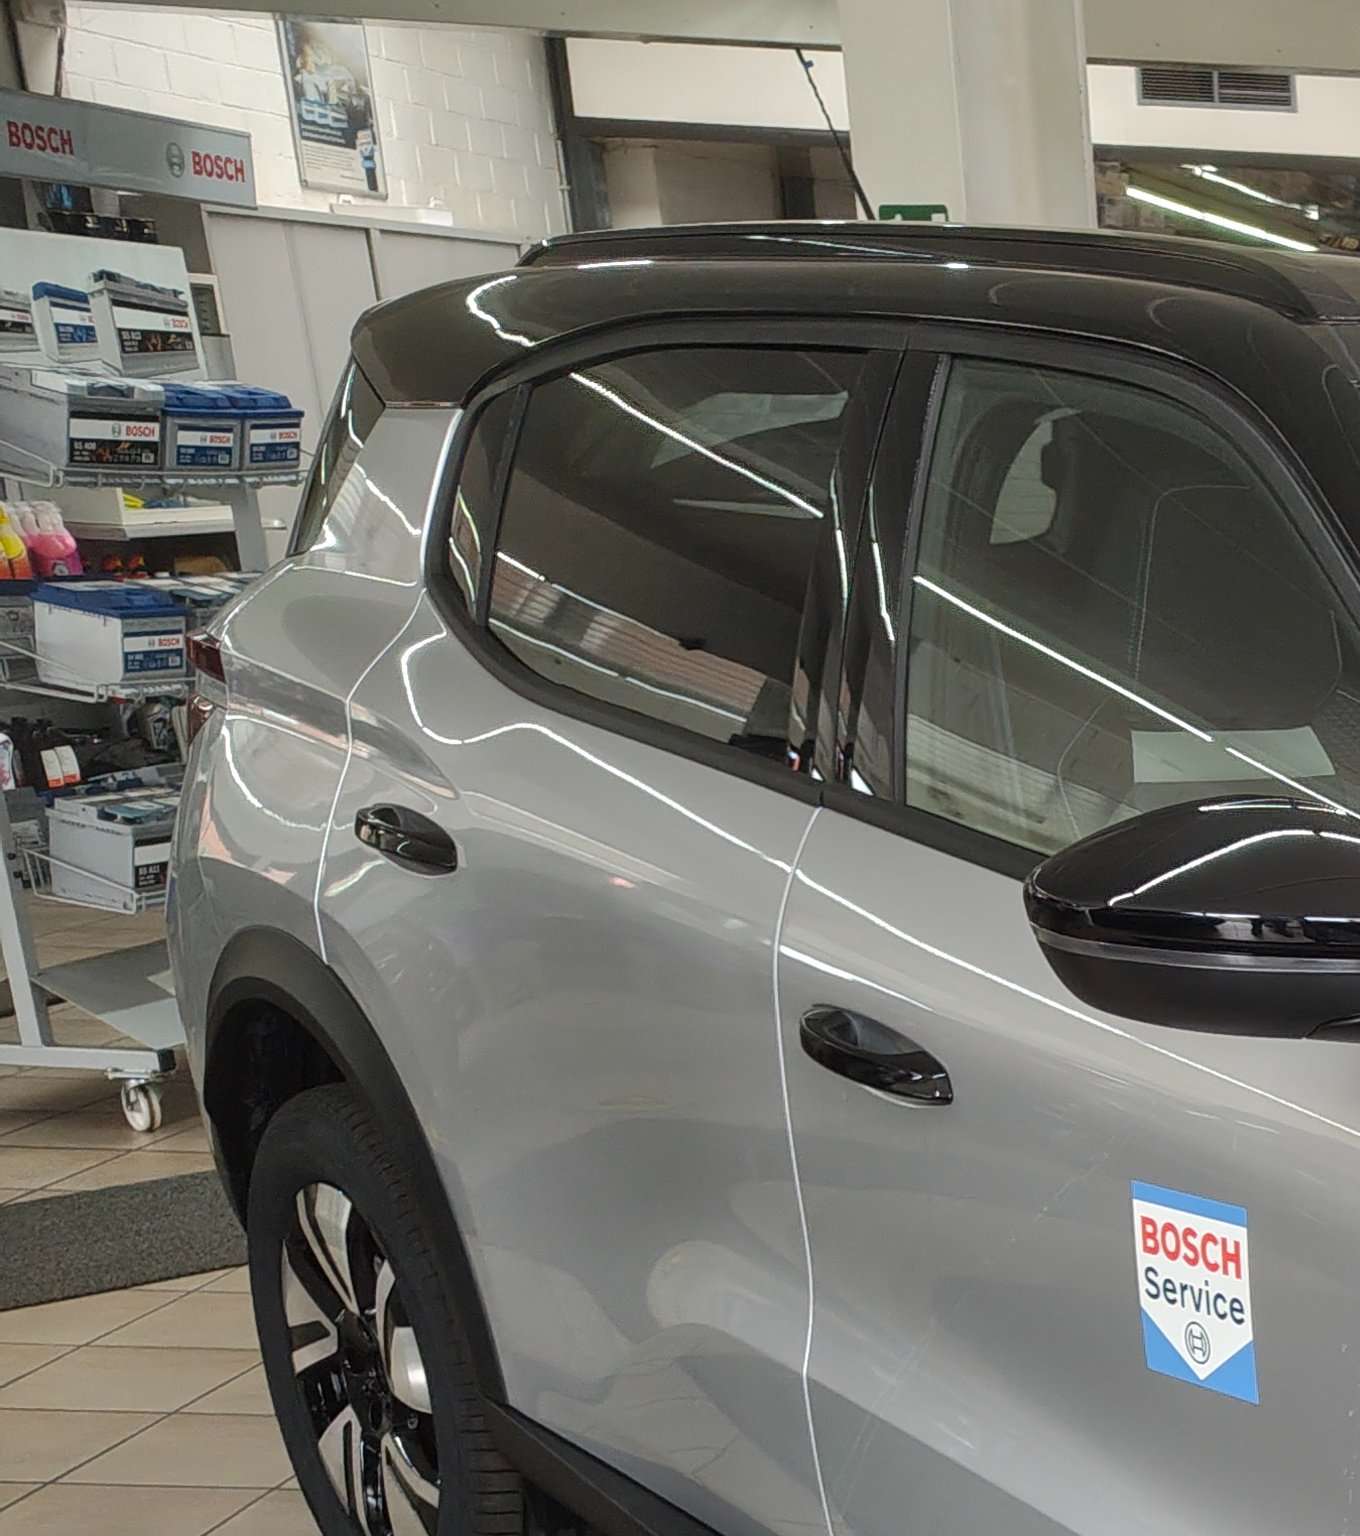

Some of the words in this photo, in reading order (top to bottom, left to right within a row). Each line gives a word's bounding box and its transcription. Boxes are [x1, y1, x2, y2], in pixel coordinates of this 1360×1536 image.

[7, 120, 74, 155] BOSCH
[192, 151, 245, 183] BOSCH
[125, 425, 155, 438] BOSCH
[278, 431, 298, 440] BOSCH
[1140, 1215, 1242, 1279] BOSCH
[1144, 1266, 1246, 1326] Service
